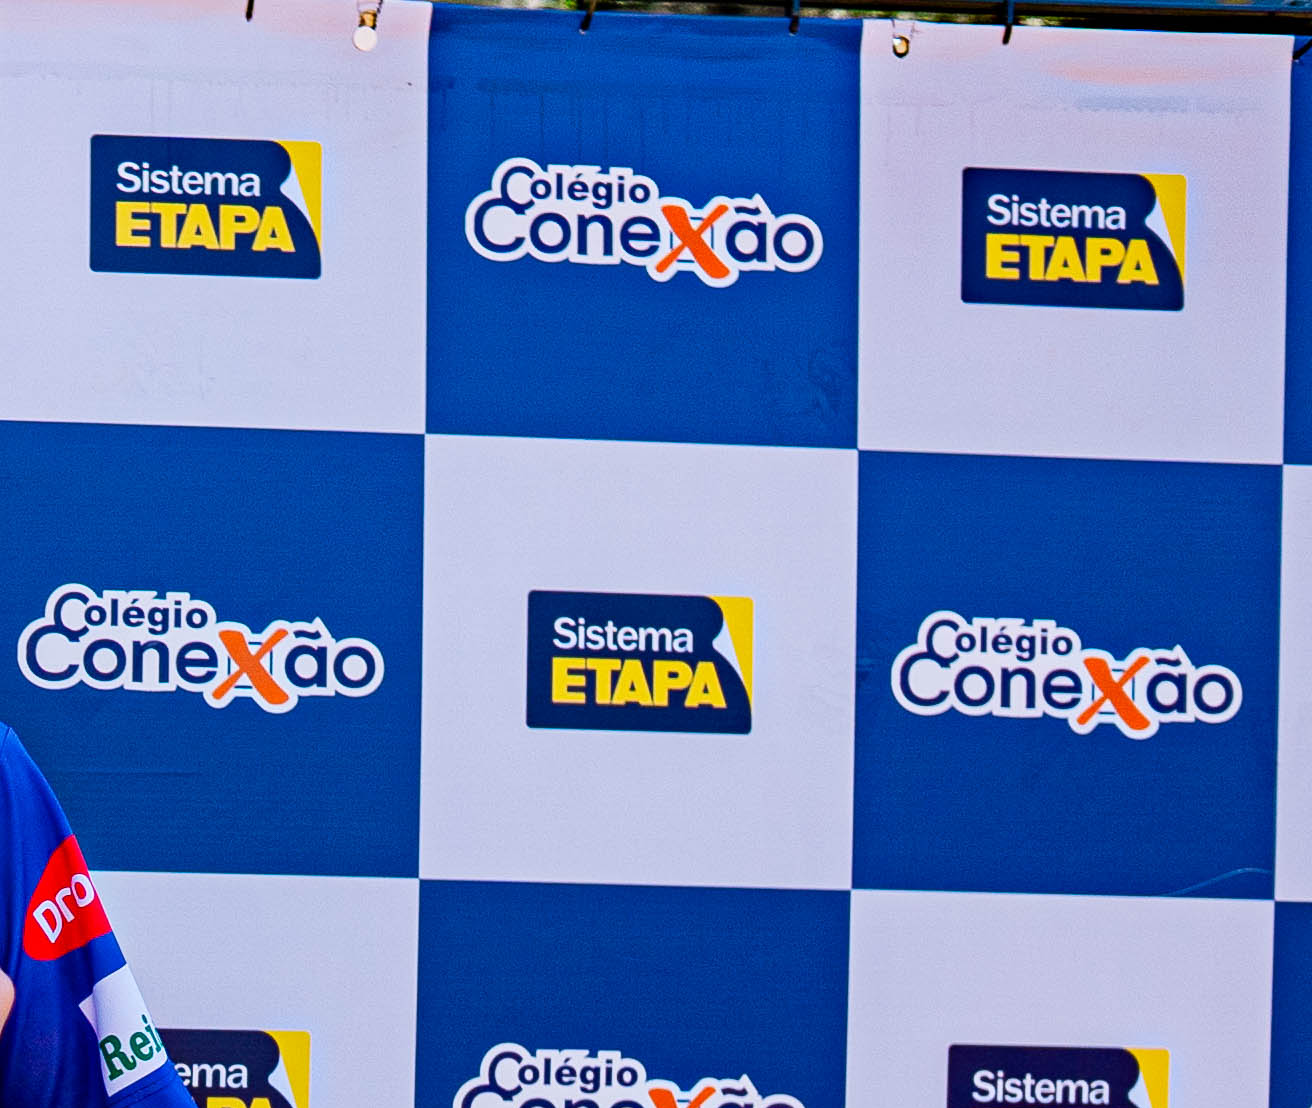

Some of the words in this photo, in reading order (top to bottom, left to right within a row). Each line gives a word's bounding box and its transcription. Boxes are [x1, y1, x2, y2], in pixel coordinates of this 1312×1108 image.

[116, 161, 260, 197] Sistema
[500, 165, 651, 210] Colégio
[115, 201, 295, 252] ETAPA
[986, 194, 1126, 230] Sistema
[985, 233, 1159, 285] ETAPA
[54, 592, 207, 634] Colégio
[553, 616, 693, 654] Sistema
[927, 618, 1071, 661] Colégio
[551, 657, 726, 708] ETAPA
[33, 873, 95, 944] Dro
[488, 1049, 638, 1096] Colégio
[973, 1068, 1109, 1106] Sistema
